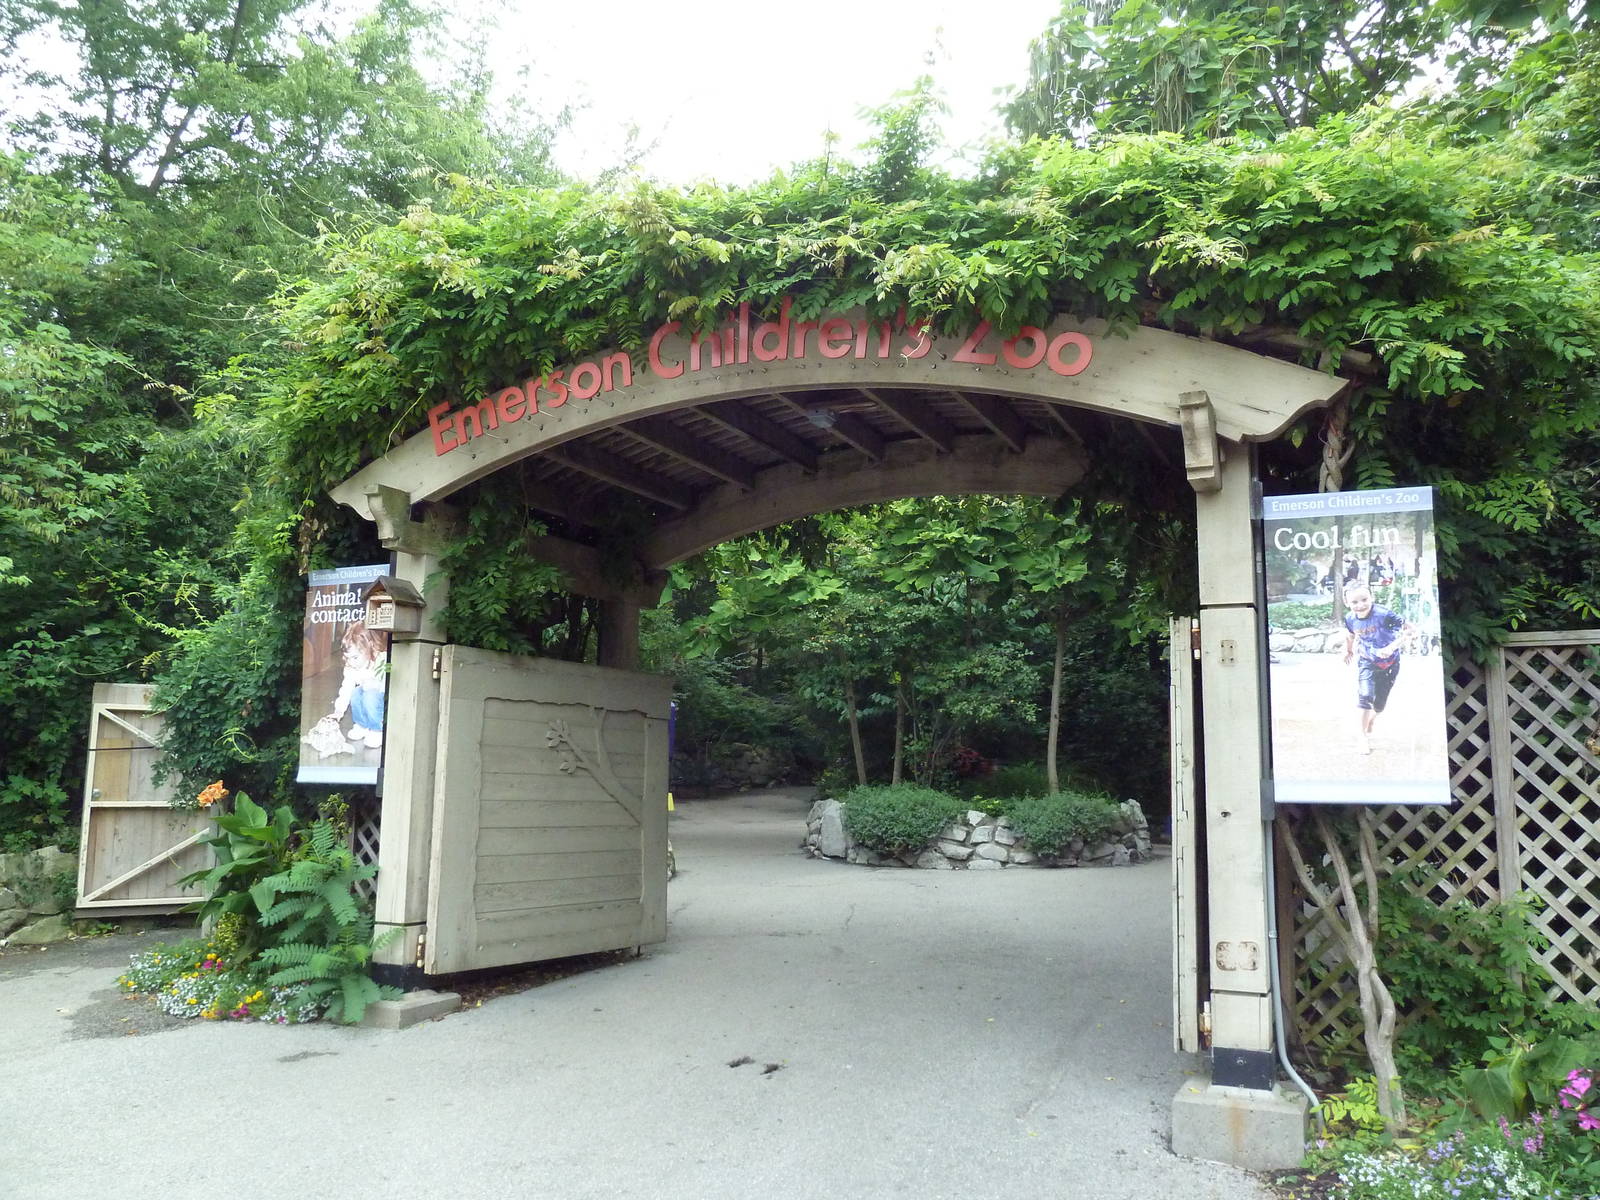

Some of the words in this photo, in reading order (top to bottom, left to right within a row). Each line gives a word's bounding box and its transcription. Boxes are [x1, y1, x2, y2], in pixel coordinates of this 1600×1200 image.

[427, 351, 632, 456] Emerson
[649, 296, 932, 379] Children's
[952, 307, 1093, 377] Zoo
[1272, 499, 1324, 512] Emerson
[1328, 494, 1393, 508] Children's
[1396, 492, 1420, 504] Zoo
[1274, 525, 1342, 551] Cool
[1350, 525, 1401, 549] fun
[340, 570, 372, 580] Children's
[373, 568, 386, 577] Zoo
[312, 588, 362, 607] Animal
[311, 607, 365, 623] contact
